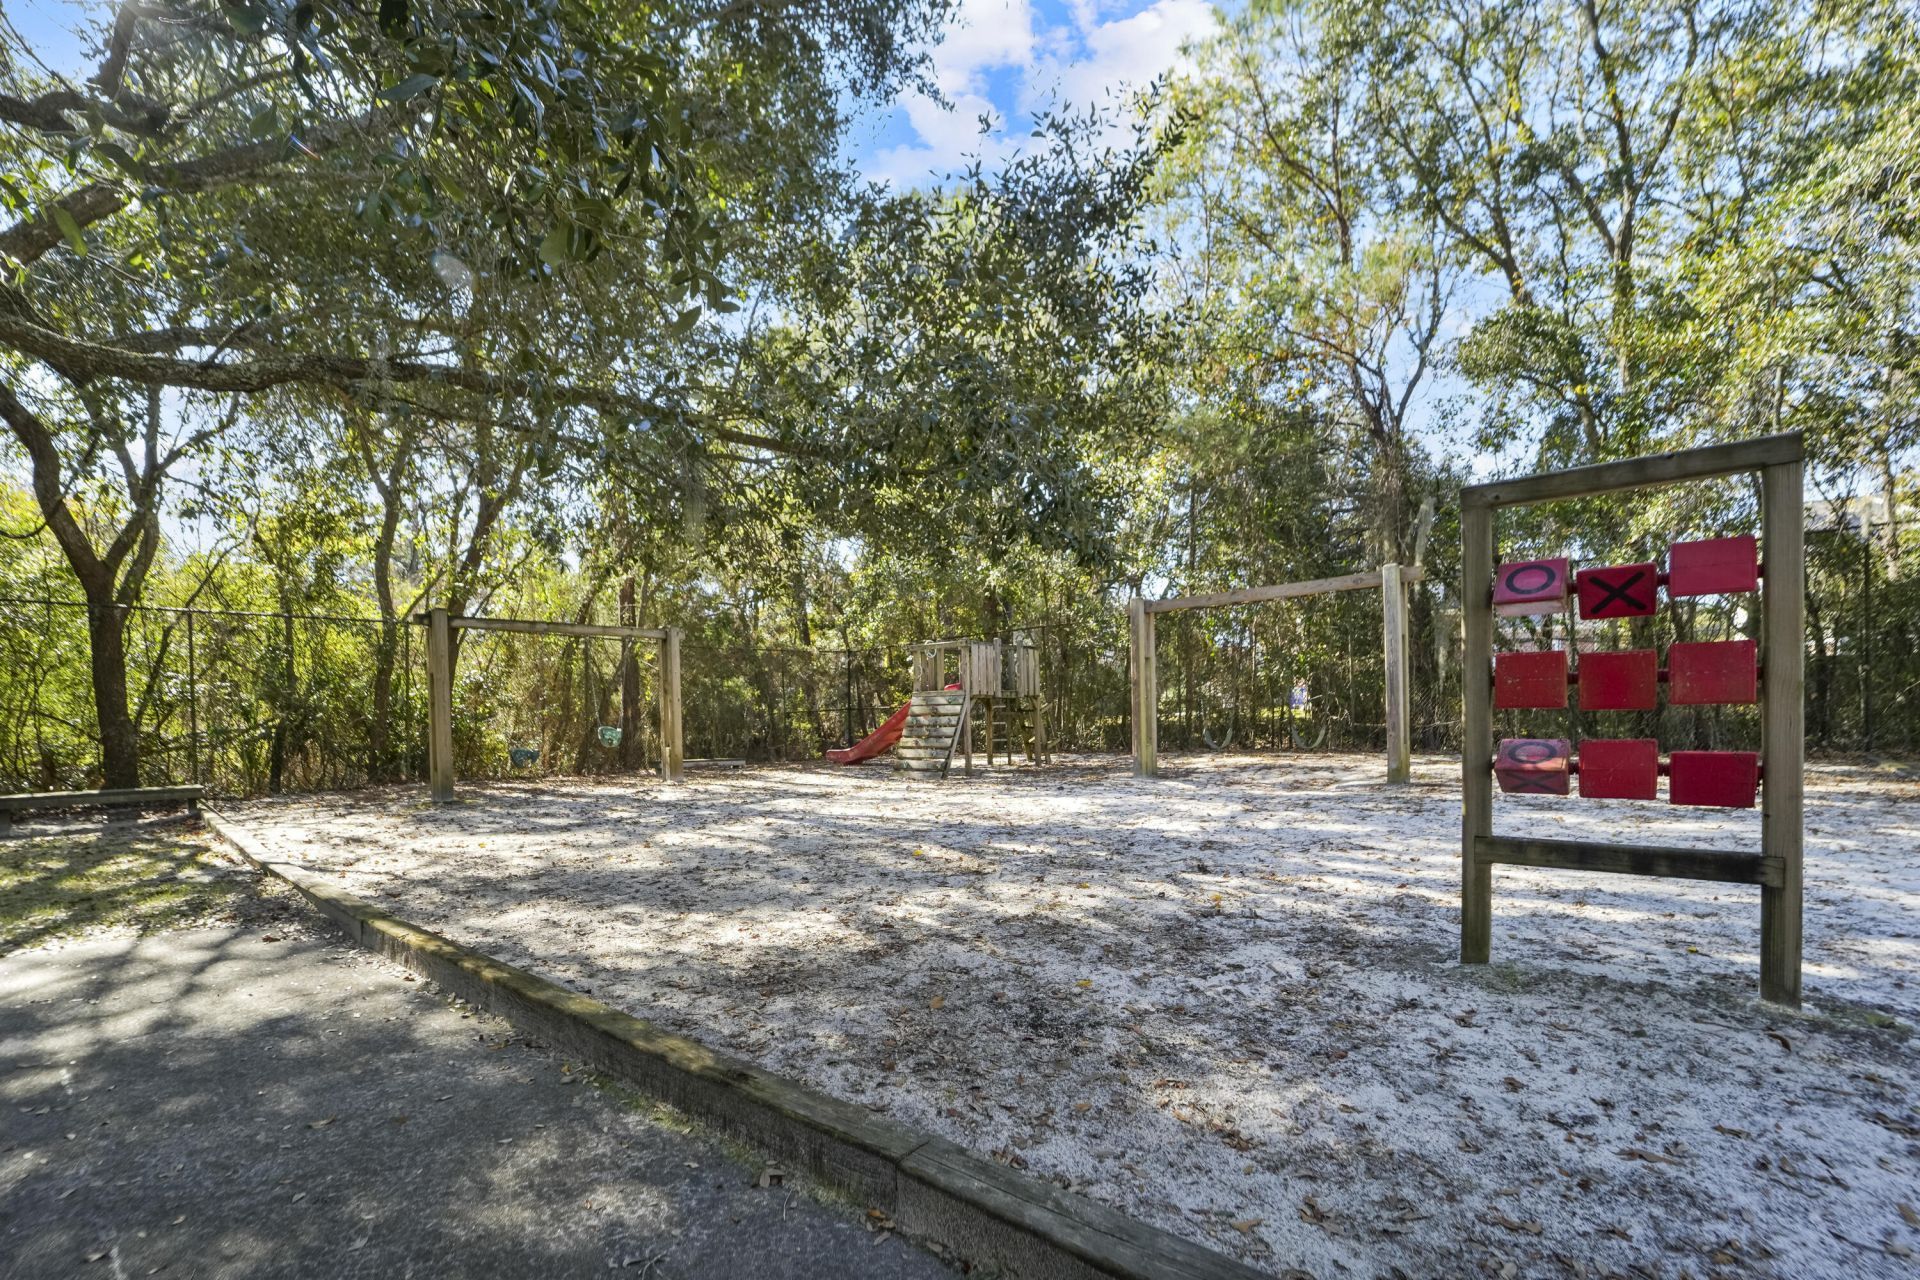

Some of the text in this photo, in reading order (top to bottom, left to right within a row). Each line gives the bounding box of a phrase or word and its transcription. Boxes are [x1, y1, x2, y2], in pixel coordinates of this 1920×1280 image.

[1505, 565, 1556, 595] O
[1589, 571, 1647, 614] X
[1508, 741, 1557, 765] O
